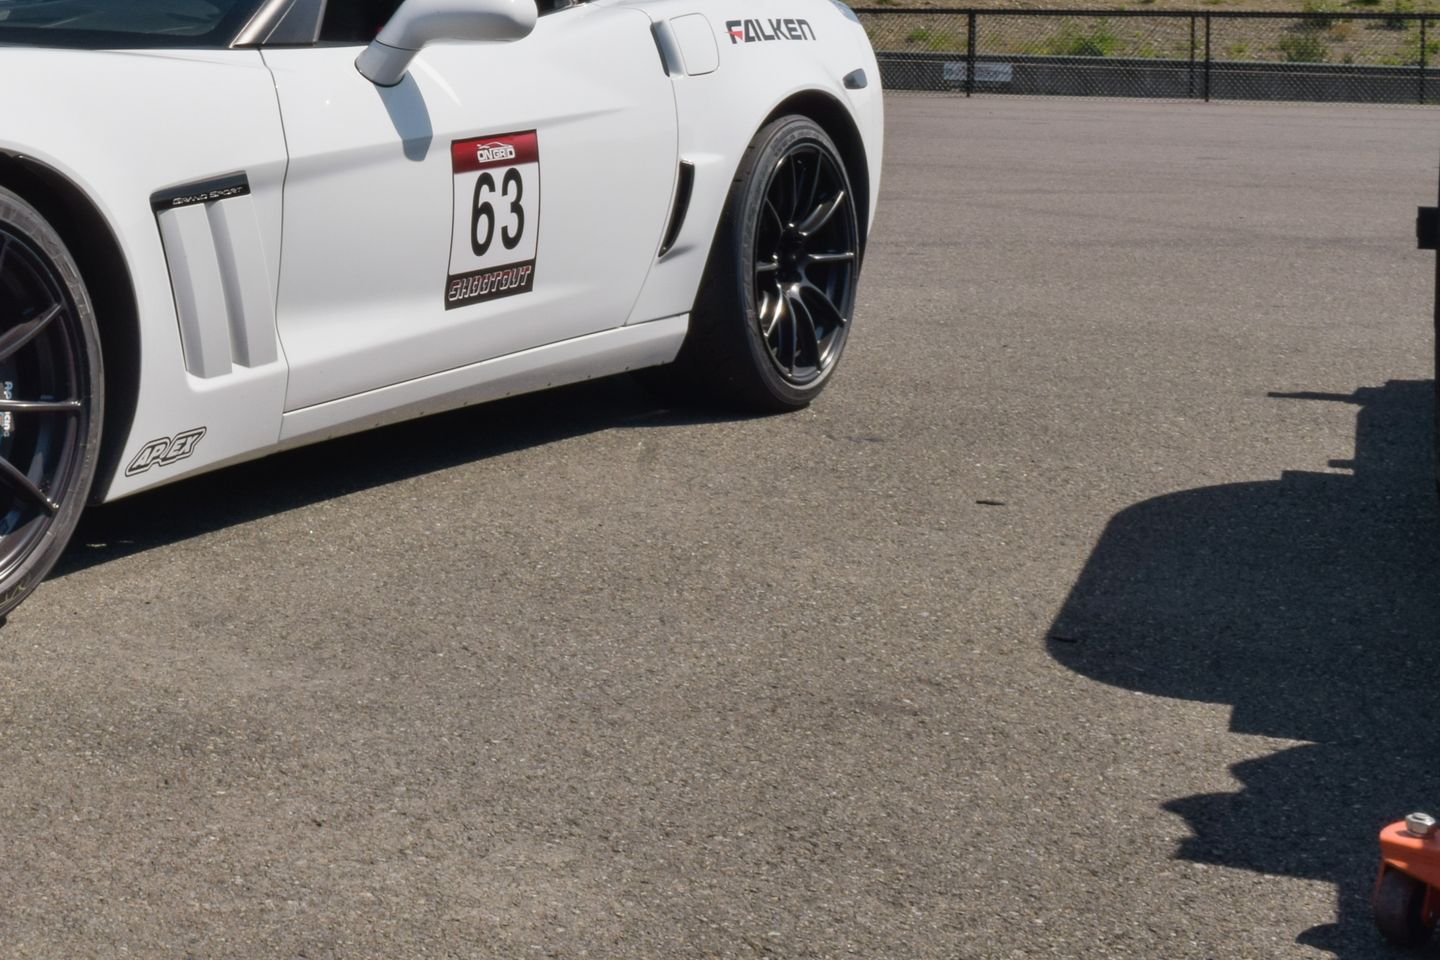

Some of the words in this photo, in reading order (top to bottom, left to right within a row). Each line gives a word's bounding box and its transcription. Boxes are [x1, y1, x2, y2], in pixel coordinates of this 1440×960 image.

[725, 18, 816, 44] FALKEN
[471, 167, 524, 257] 63
[448, 265, 531, 301] SHOOTOUT
[126, 428, 205, 474] APEX
